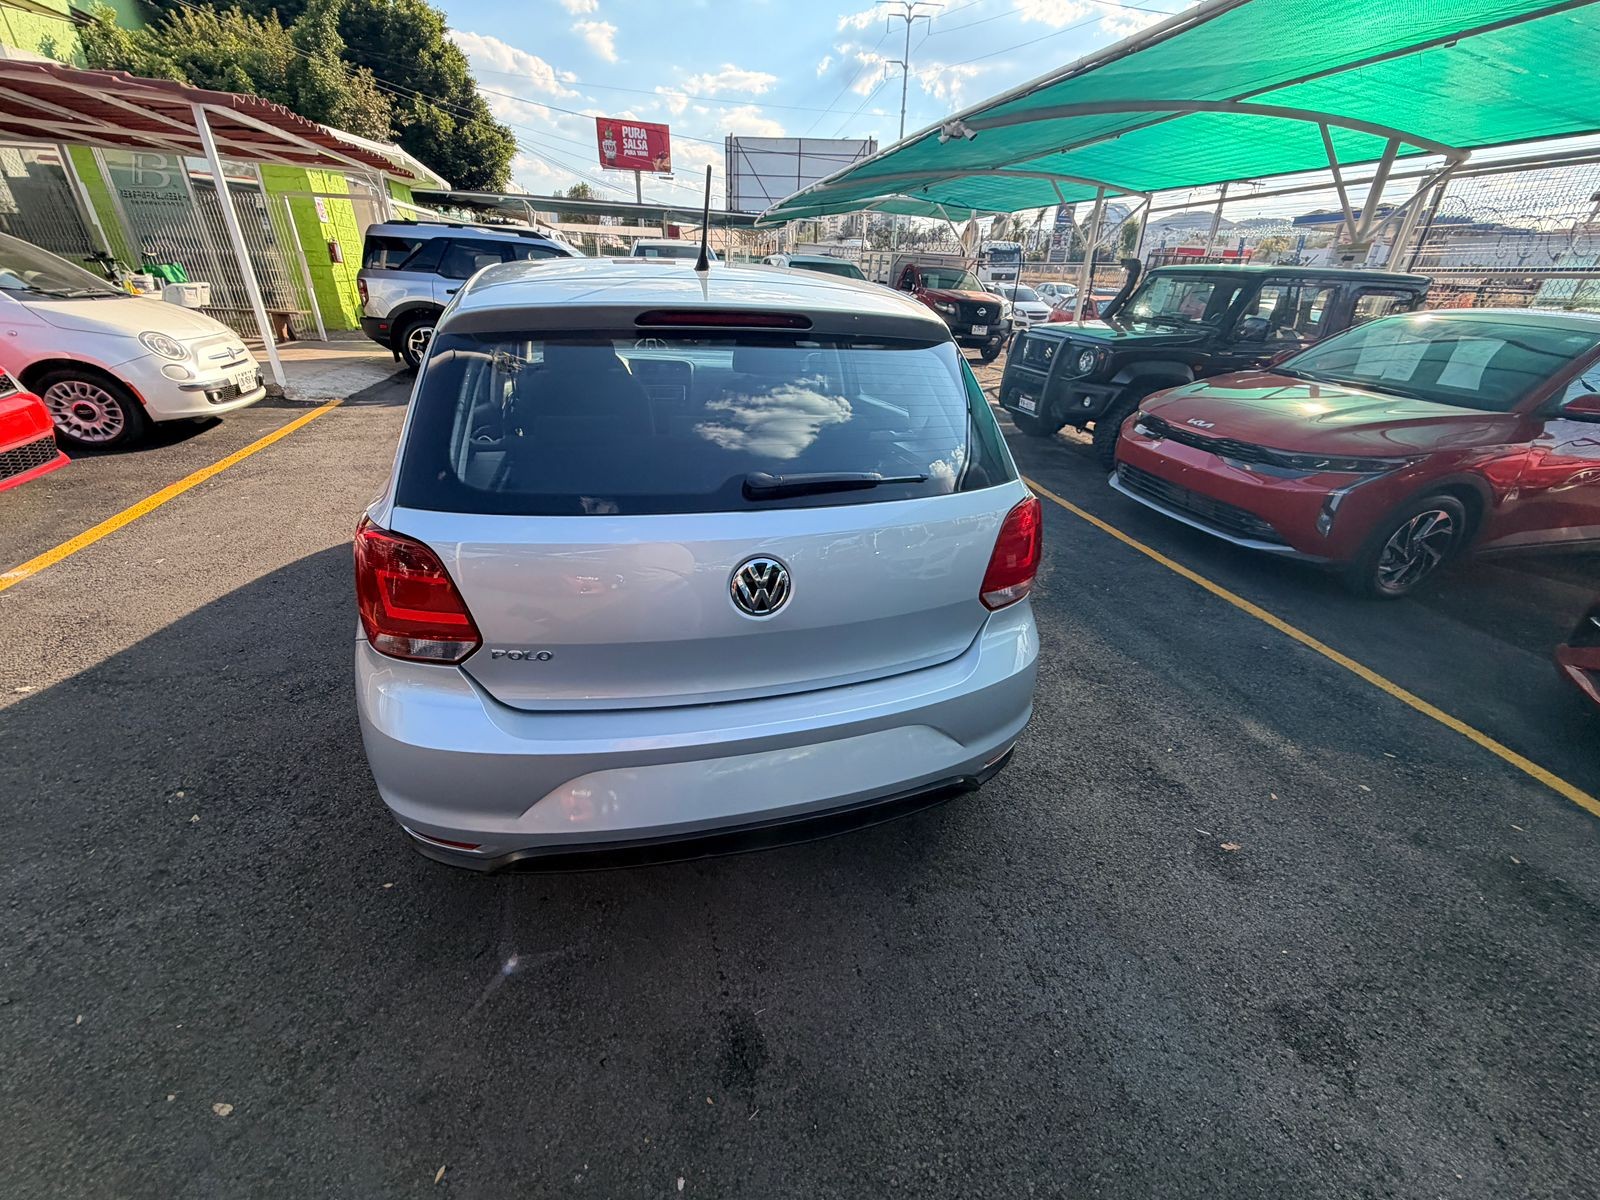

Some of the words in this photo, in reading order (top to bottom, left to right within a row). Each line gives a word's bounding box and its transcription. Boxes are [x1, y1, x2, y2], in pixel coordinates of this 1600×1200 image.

[622, 126, 647, 140] PURA
[623, 139, 648, 150] SALSA
[1186, 418, 1216, 429] KIA
[491, 648, 554, 661] POLO
